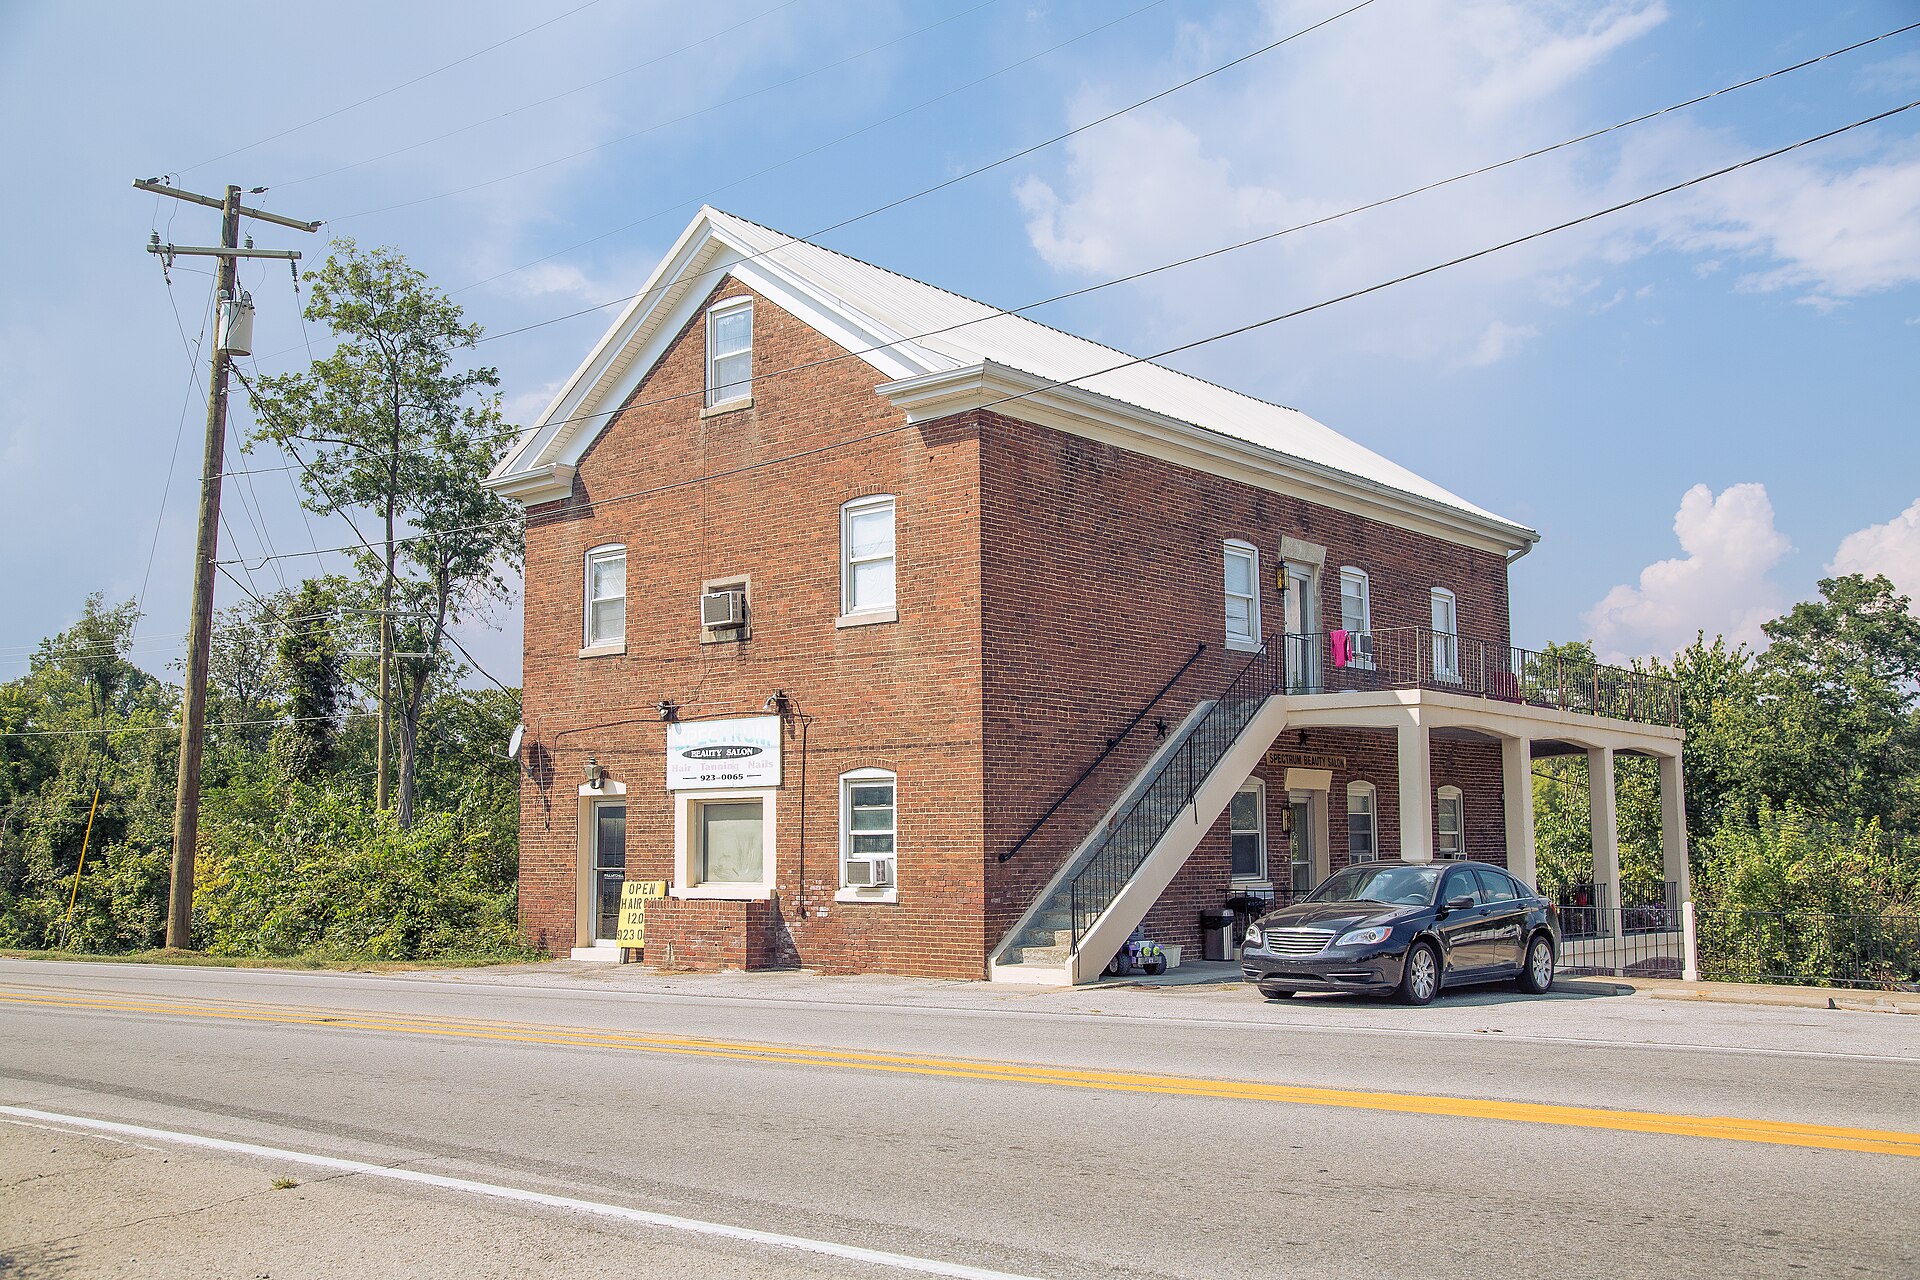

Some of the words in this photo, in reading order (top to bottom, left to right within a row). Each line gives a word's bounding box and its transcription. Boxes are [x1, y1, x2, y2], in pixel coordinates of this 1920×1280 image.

[691, 749, 722, 758] BEAUTY
[726, 748, 753, 756] SALON
[672, 764, 692, 772] Hair
[700, 761, 740, 772] Tanning
[747, 760, 774, 769] Nails
[1269, 753, 1302, 765] SPECTRUM
[1303, 755, 1326, 767] BEAUTY
[1327, 757, 1345, 768] SALON
[700, 773, 744, 781] 923-0065
[628, 883, 656, 895] OPEN
